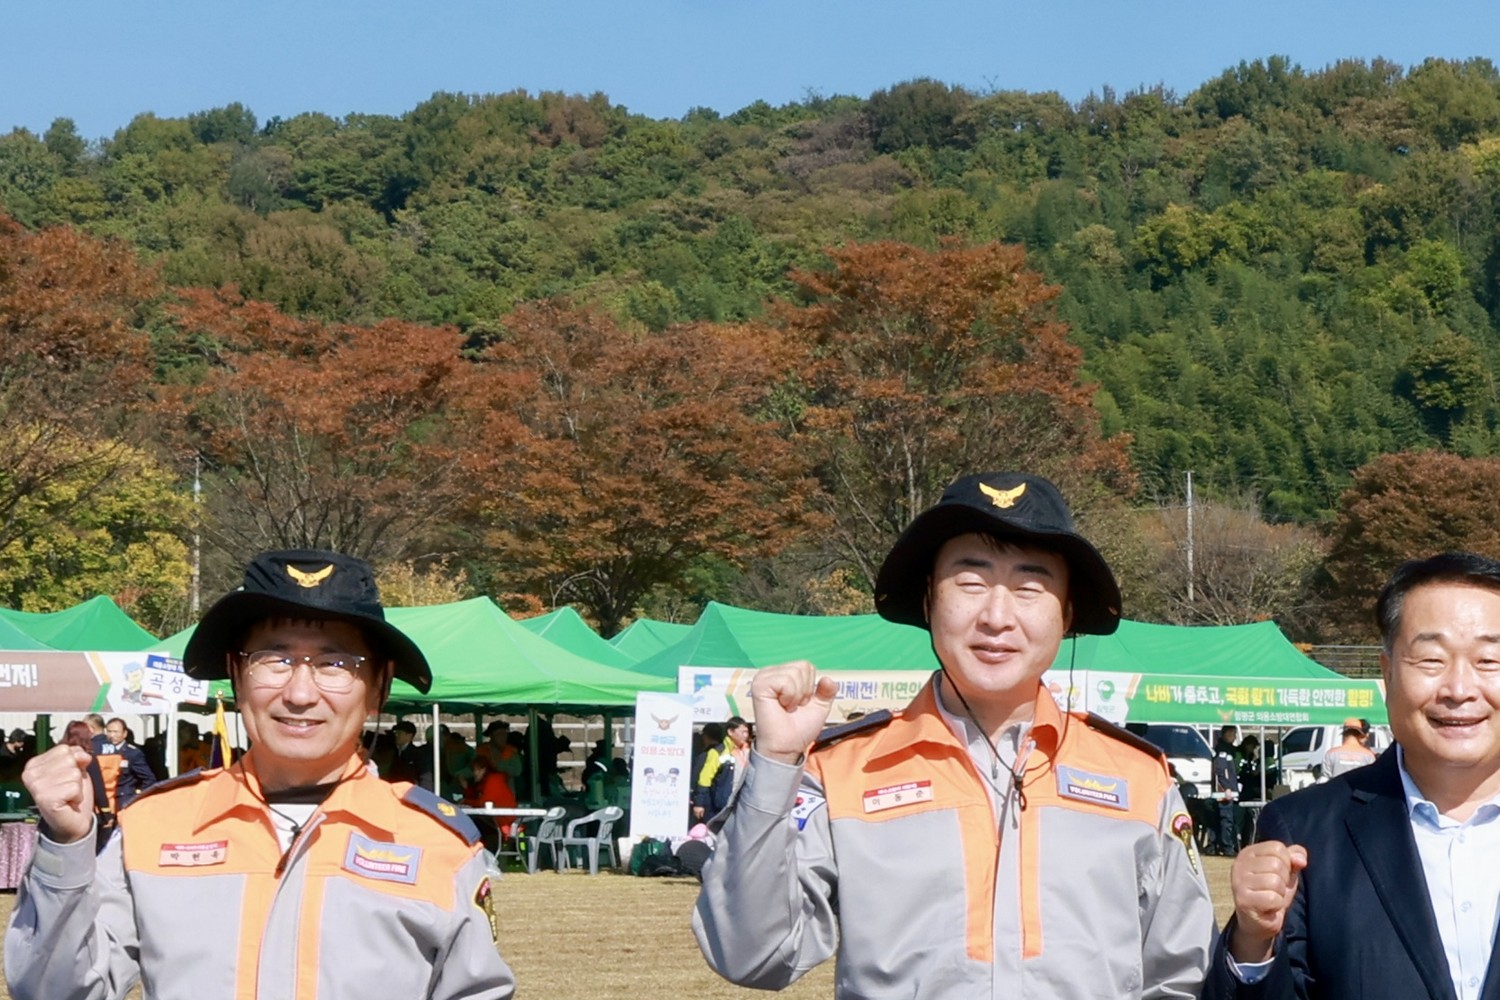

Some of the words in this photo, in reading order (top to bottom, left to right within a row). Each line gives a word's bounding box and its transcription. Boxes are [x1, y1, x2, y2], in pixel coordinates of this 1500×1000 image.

[150, 673, 202, 696] 곡성군
[1145, 685, 1182, 703] 나비가
[1277, 688, 1310, 707] 가득한
[1312, 689, 1346, 707] 안전한
[355, 855, 391, 872] VOLUNTEER
[391, 864, 407, 874] FIRE
